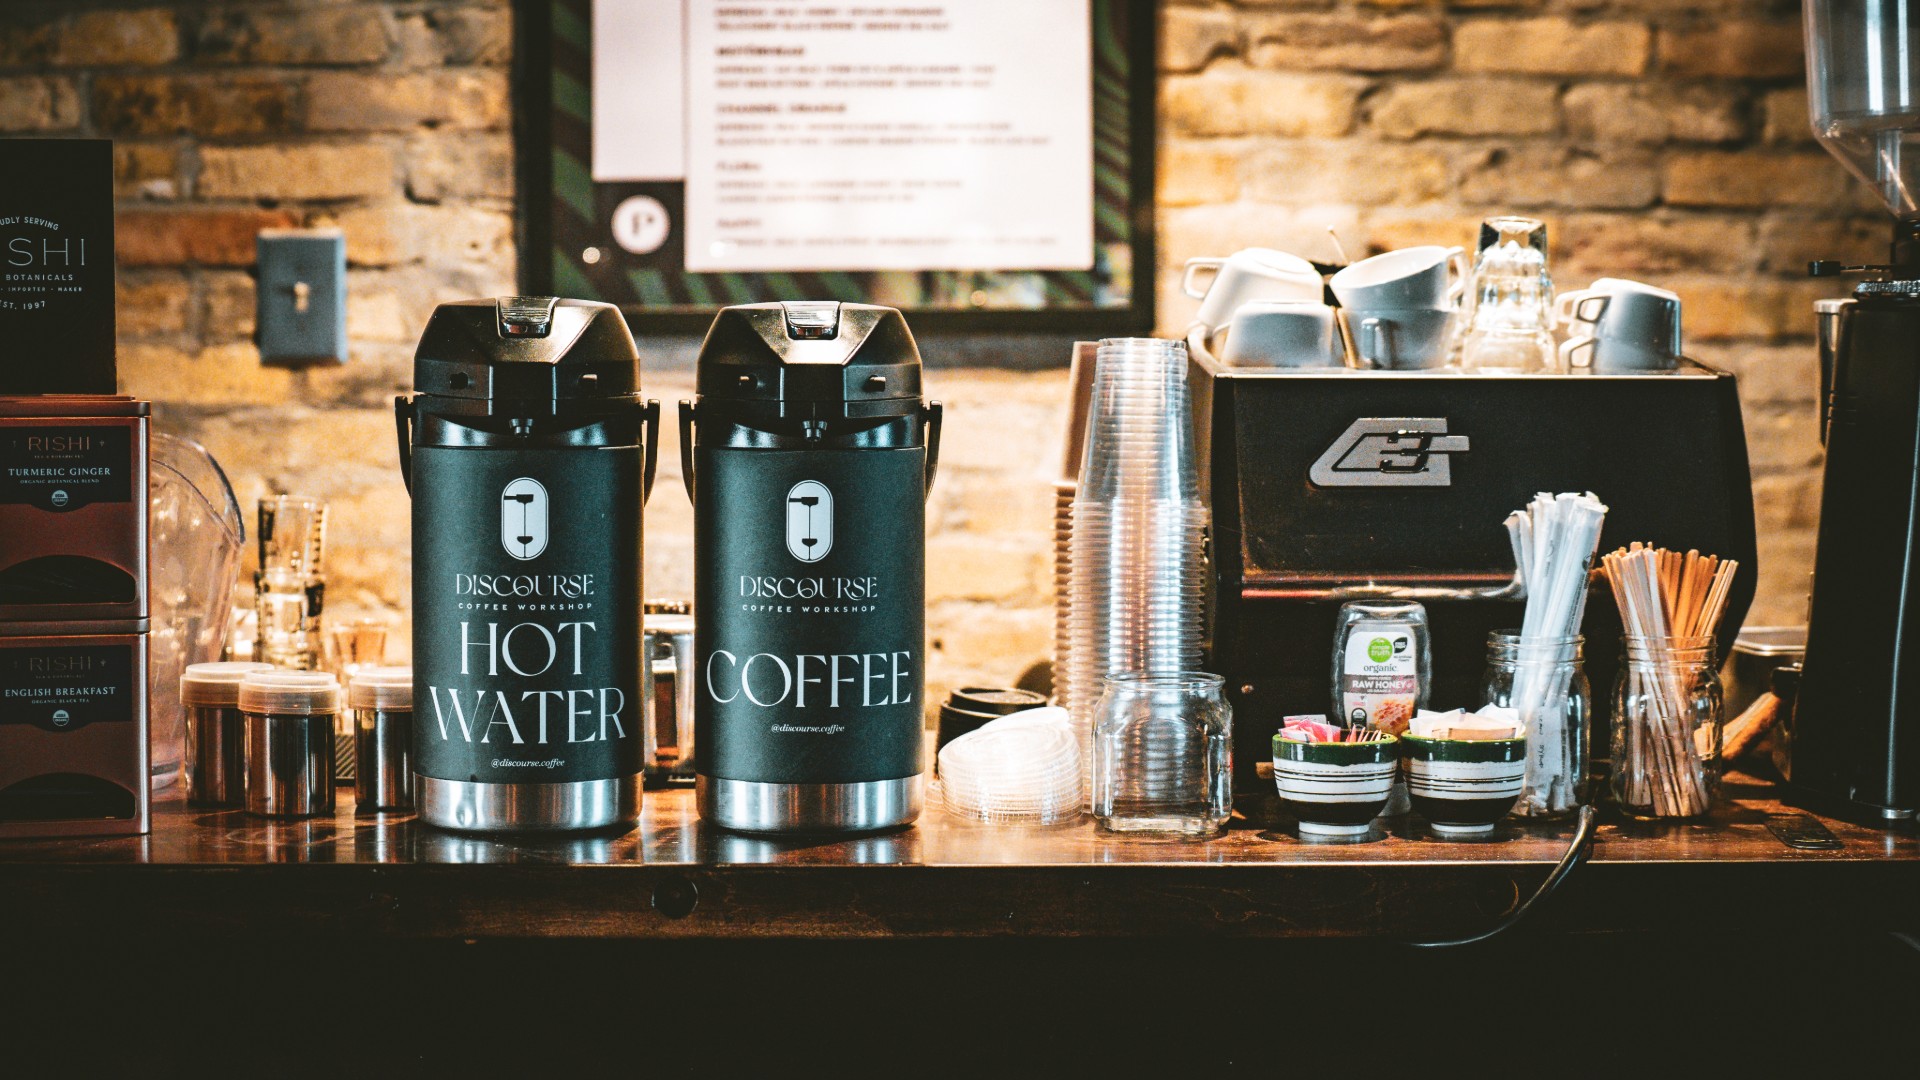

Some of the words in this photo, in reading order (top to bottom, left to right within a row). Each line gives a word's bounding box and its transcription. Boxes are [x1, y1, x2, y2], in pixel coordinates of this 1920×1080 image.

[24, 216, 59, 231] SERVING
[23, 300, 46, 310] 1997
[28, 436, 90, 452] RISHI
[8, 468, 65, 476] TURMERIC
[69, 467, 111, 476] GINGER
[456, 573, 595, 598] DISCOURSE
[740, 575, 878, 601] DISCOURSE
[458, 602, 508, 611] COFFEE
[518, 602, 592, 611] WORKSHOP
[742, 604, 792, 613] COFFEE
[802, 604, 876, 613] WORKSHOP
[460, 621, 597, 677] HOT
[29, 656, 91, 672] RISHI
[1363, 663, 1397, 673] organic
[706, 649, 912, 708] COFFEE
[1352, 681, 1374, 689] RAW
[1375, 681, 1406, 689] HONEY
[5, 688, 51, 697] ENGLISH
[56, 686, 116, 696] BREAKFAST
[429, 685, 626, 745] WATER
[770, 723, 845, 735] @discourse.coffee
[490, 758, 566, 770] @discourse.coffee
